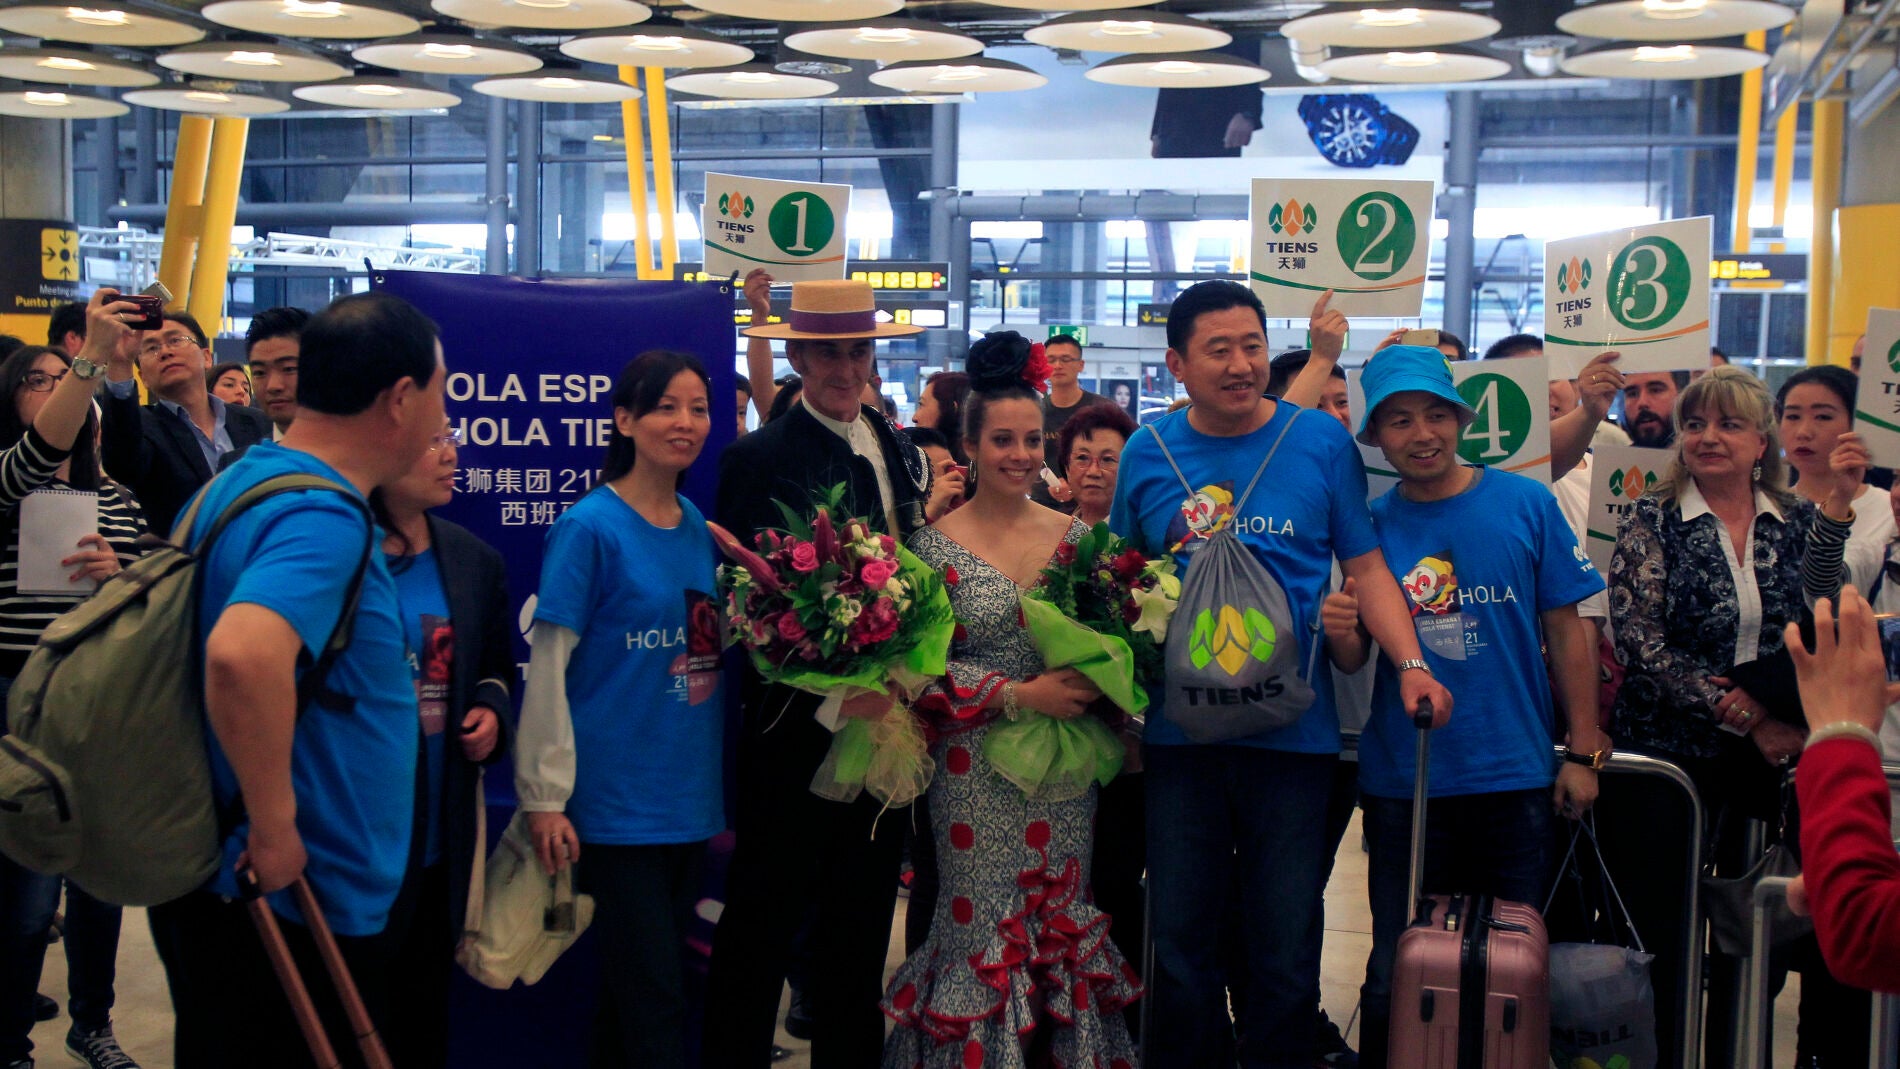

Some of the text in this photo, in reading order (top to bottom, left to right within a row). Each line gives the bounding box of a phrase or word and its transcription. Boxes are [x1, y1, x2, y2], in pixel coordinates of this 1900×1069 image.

[716, 220, 755, 233] TIENS
[791, 197, 814, 252] 1
[1354, 199, 1397, 273] 2
[1266, 242, 1318, 253] TIENS
[1621, 244, 1668, 324] 3
[15, 295, 48, 308] Punto
[1556, 297, 1592, 314] TIENS
[539, 374, 612, 403] ESP
[1462, 380, 1511, 458] 4
[1235, 515, 1295, 537] HOLA
[1458, 585, 1517, 606] HOLA
[626, 626, 686, 650] HOLA
[1464, 632, 1479, 645] 21
[673, 675, 688, 689] 21
[1181, 675, 1286, 707] TIENS
